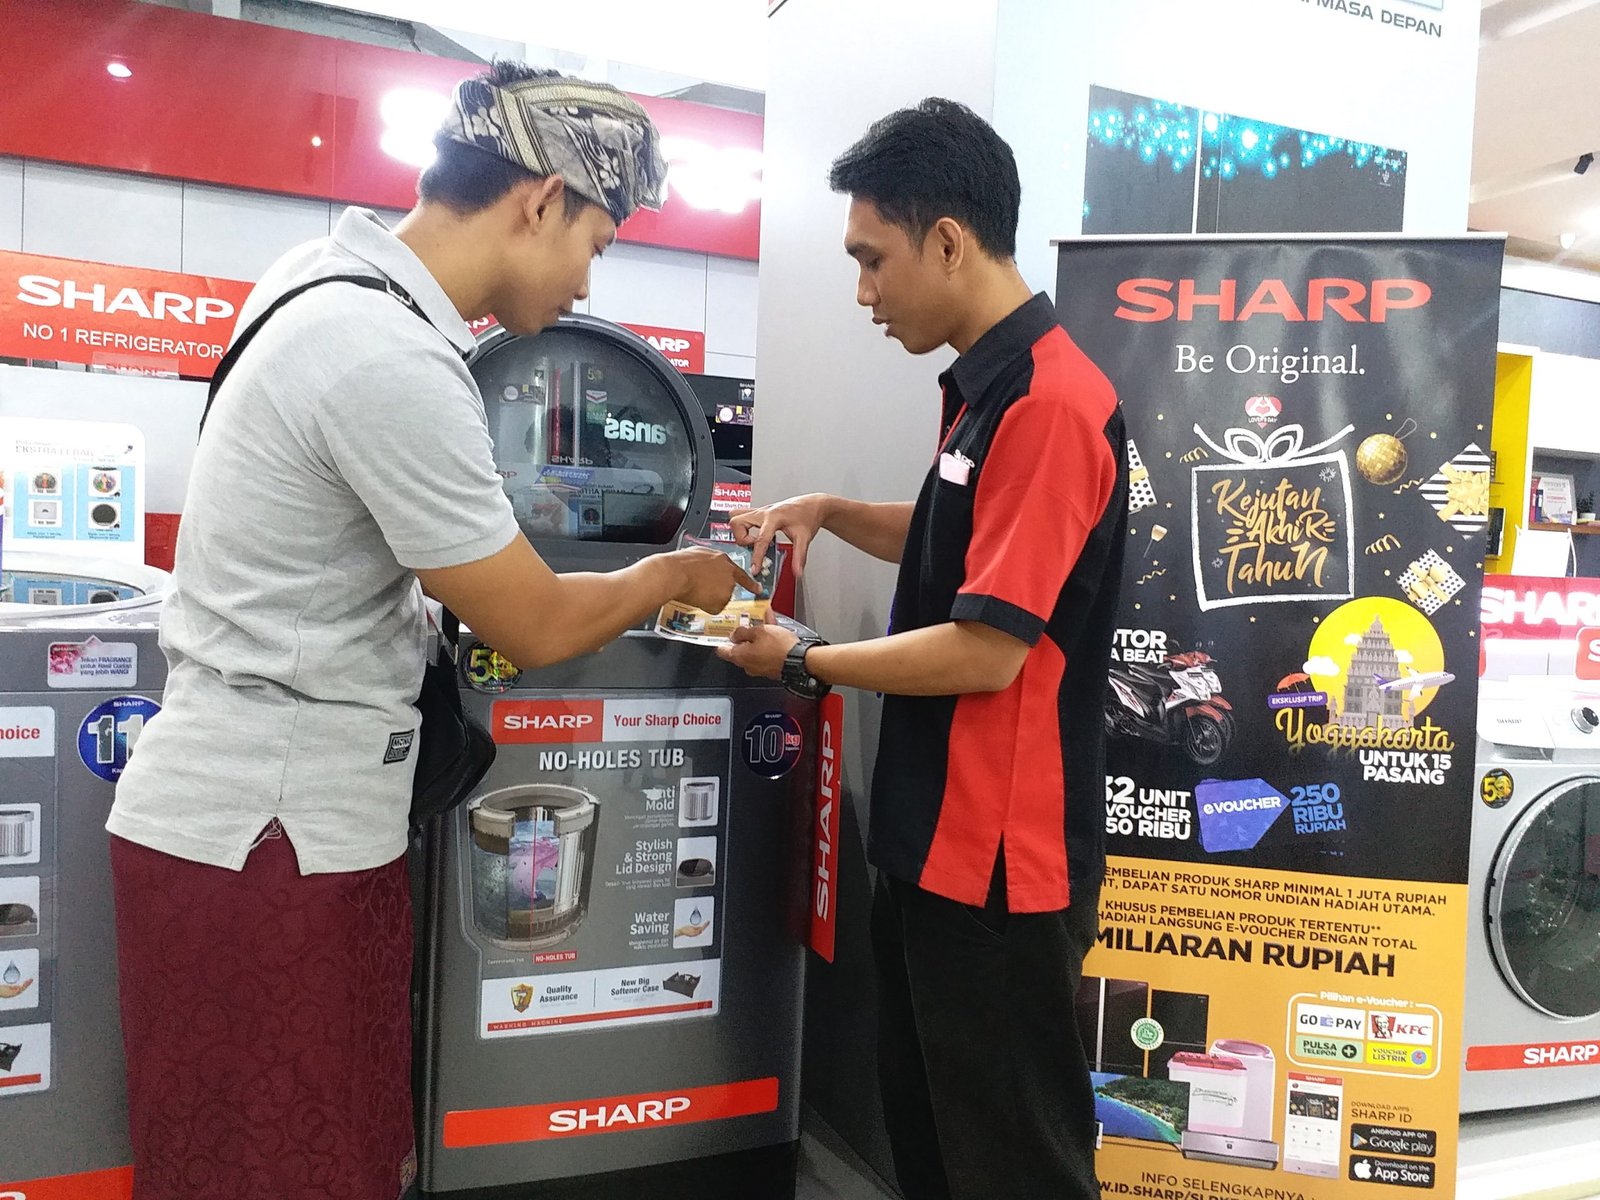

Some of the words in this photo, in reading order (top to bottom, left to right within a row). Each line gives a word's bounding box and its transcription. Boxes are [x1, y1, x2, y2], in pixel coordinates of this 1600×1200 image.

[1317, 0, 1373, 20] MASA
[1381, 9, 1442, 38] DEPAN
[17, 274, 235, 325] SHARP
[1113, 277, 1432, 323] SHARP
[23, 323, 53, 341] NO
[60, 327, 69, 343] 1
[75, 329, 224, 360] REFRIGERATOR
[641, 335, 691, 353] ARP
[1174, 343, 1215, 374] Be
[1225, 343, 1366, 384] Original.
[1211, 477, 1321, 528] Kejutan
[1480, 586, 1600, 627] SHAR
[1113, 628, 1168, 650] TOR
[1122, 649, 1169, 664] BEAT
[113, 700, 145, 708] SHARP
[1271, 695, 1307, 705] EKSKLUSIF
[1307, 694, 1324, 704] TRIP
[503, 714, 593, 730] SHARP
[614, 713, 641, 728] Your
[645, 713, 680, 730] Sharp
[683, 712, 722, 726] Choice
[87, 713, 144, 764] 11
[1275, 707, 1456, 756] Yogyakarta
[744, 724, 785, 764] 10
[785, 732, 801, 747] kg
[539, 749, 642, 772] NO-HOLES
[647, 747, 685, 769] TUB
[1358, 749, 1429, 769] UNTUK
[1431, 753, 1452, 770] 15
[1363, 765, 1446, 786] PASANG
[1139, 787, 1192, 808] UNIT
[1289, 782, 1341, 807] 250
[646, 799, 675, 812] Mold
[1105, 805, 1192, 824] VOUCHER
[1292, 802, 1345, 824] RIBU
[816, 719, 834, 921] SHARP
[1294, 819, 1347, 835] RUPIAH
[1137, 821, 1192, 841] RIBU
[635, 838, 673, 853] Stylish
[624, 852, 633, 863] &
[635, 851, 673, 864] Strong
[615, 864, 633, 875] Lid
[635, 862, 673, 876] Design
[1174, 872, 1231, 887] PRODUK
[1234, 878, 1280, 891] SHARP
[1284, 883, 1343, 898] MINIMAL
[1347, 888, 1353, 899] 1
[1356, 889, 1392, 901] JUTA
[1396, 893, 1448, 905] RUPIAH
[1122, 879, 1168, 893] DAPAT
[1171, 883, 1207, 896] SATU
[1210, 887, 1263, 902] NOMOR
[1265, 892, 1321, 907] UNDIAN
[1324, 900, 1379, 913] HADIAH
[1382, 904, 1436, 917] UTAMA.
[634, 911, 670, 924] Water
[1105, 899, 1157, 914] KHUSUS
[1160, 905, 1236, 921] PEMBELIAN
[1239, 912, 1296, 928] PRODUK
[629, 922, 670, 937] Saving
[1149, 915, 1223, 932] LANGSUNG
[1226, 923, 1306, 940] E-VOUCHER
[1309, 931, 1369, 947] DENGAN
[1372, 936, 1418, 951] TOTAL
[564, 952, 577, 961] TUB
[1092, 926, 1253, 964] MILIARAN
[1262, 941, 1396, 978] RUPIAH
[546, 984, 573, 994] Quality
[610, 985, 642, 997] Softener
[642, 983, 660, 994] Case
[620, 977, 637, 988] New
[638, 976, 651, 987] Big
[539, 993, 579, 1003] Assurance
[1299, 1014, 1318, 1026] GO
[1335, 1017, 1362, 1031] PAY
[1395, 1023, 1431, 1036] KFC
[1303, 1040, 1338, 1051] PULSA
[1303, 1047, 1337, 1057] TELEPON
[1372, 1047, 1408, 1056] VOUCHER
[1523, 1044, 1600, 1065] SHARP
[1372, 1054, 1407, 1063] LISTRIK
[547, 1096, 692, 1133] SHARP
[1351, 1101, 1391, 1111] DOWNLOAD
[1351, 1108, 1396, 1123] SHARP
[1399, 1113, 1413, 1124] ID
[1370, 1127, 1401, 1137] ANDROID
[1417, 1132, 1428, 1140] ON
[1369, 1136, 1410, 1154] Google
[1411, 1140, 1434, 1155] play
[1374, 1159, 1408, 1171] Download
[1409, 1163, 1418, 1171] on
[1418, 1164, 1431, 1173] the
[1374, 1168, 1399, 1183] App
[1400, 1169, 1431, 1184] Store
[1141, 1171, 1178, 1187] INFO
[1182, 1176, 1305, 1200] SELENGKAPNYA
